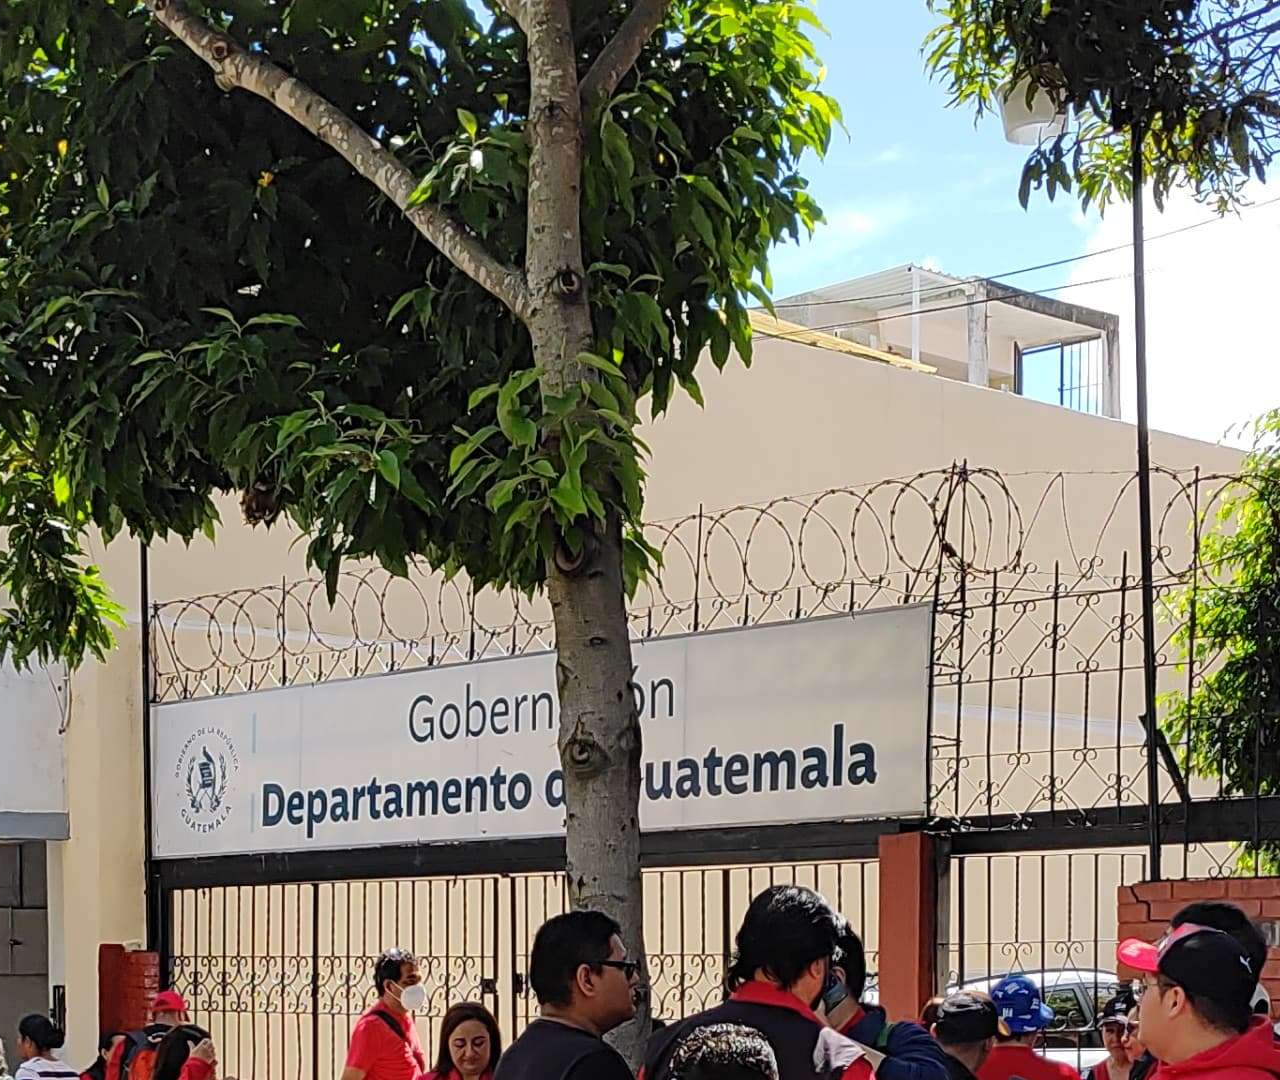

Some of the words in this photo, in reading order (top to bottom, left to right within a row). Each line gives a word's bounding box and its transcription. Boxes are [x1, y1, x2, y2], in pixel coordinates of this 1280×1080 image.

[408, 665, 675, 743] Gobernón
[180, 805, 233, 833] GUATEMALA
[261, 766, 532, 839] Departamento
[644, 723, 878, 801] uatemala
